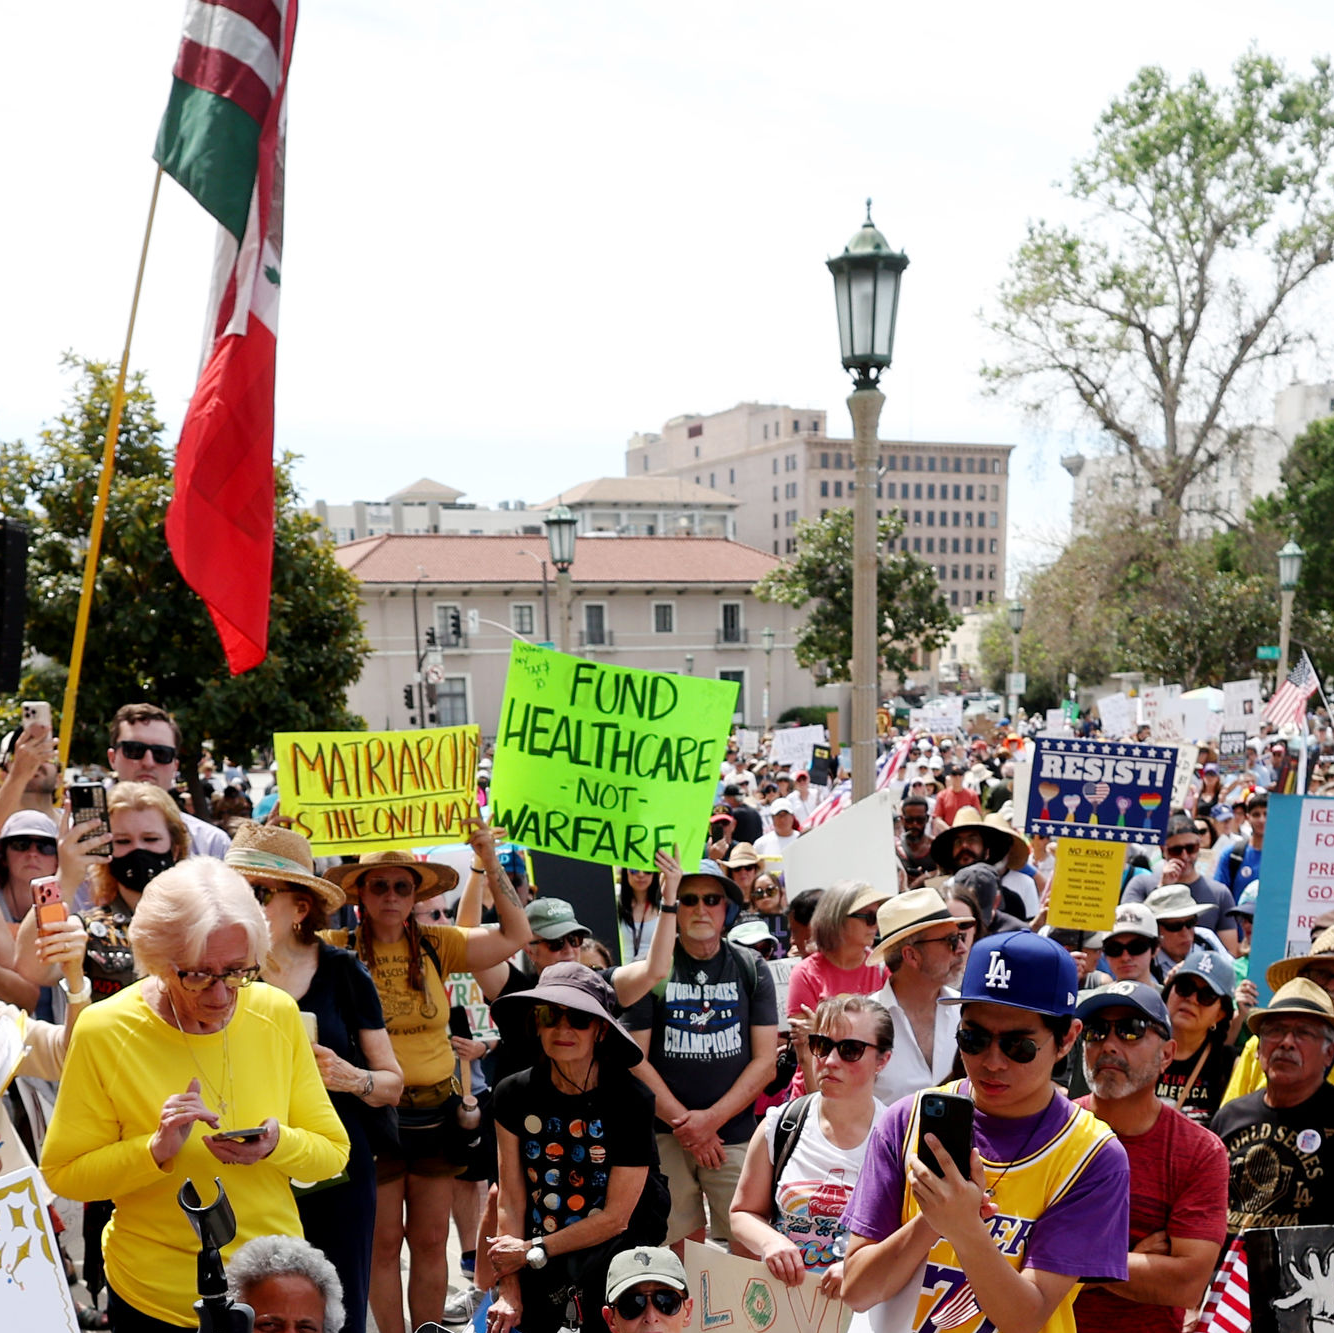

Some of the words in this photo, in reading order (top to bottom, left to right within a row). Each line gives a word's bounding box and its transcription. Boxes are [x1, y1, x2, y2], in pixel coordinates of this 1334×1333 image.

[569, 662, 678, 721] FUND
[503, 698, 716, 784] HEALTHCARE
[290, 730, 482, 799] MATRIARCHY
[1039, 754, 1167, 788] RESIST!
[319, 806, 372, 841] THE
[373, 801, 428, 840] ONLY
[1310, 808, 1334, 823] ICE
[493, 799, 676, 868] WARFARE
[984, 950, 1012, 989] LA
[1196, 952, 1215, 975] LA
[665, 981, 702, 1003] WORLD
[702, 981, 740, 1002] SERIES
[672, 1009, 685, 1020] 20
[663, 1022, 743, 1055] CHAMPIONS
[1161, 1073, 1203, 1087] KINS
[1226, 1121, 1273, 1160] ORLD
[1293, 1180, 1315, 1209] LA
